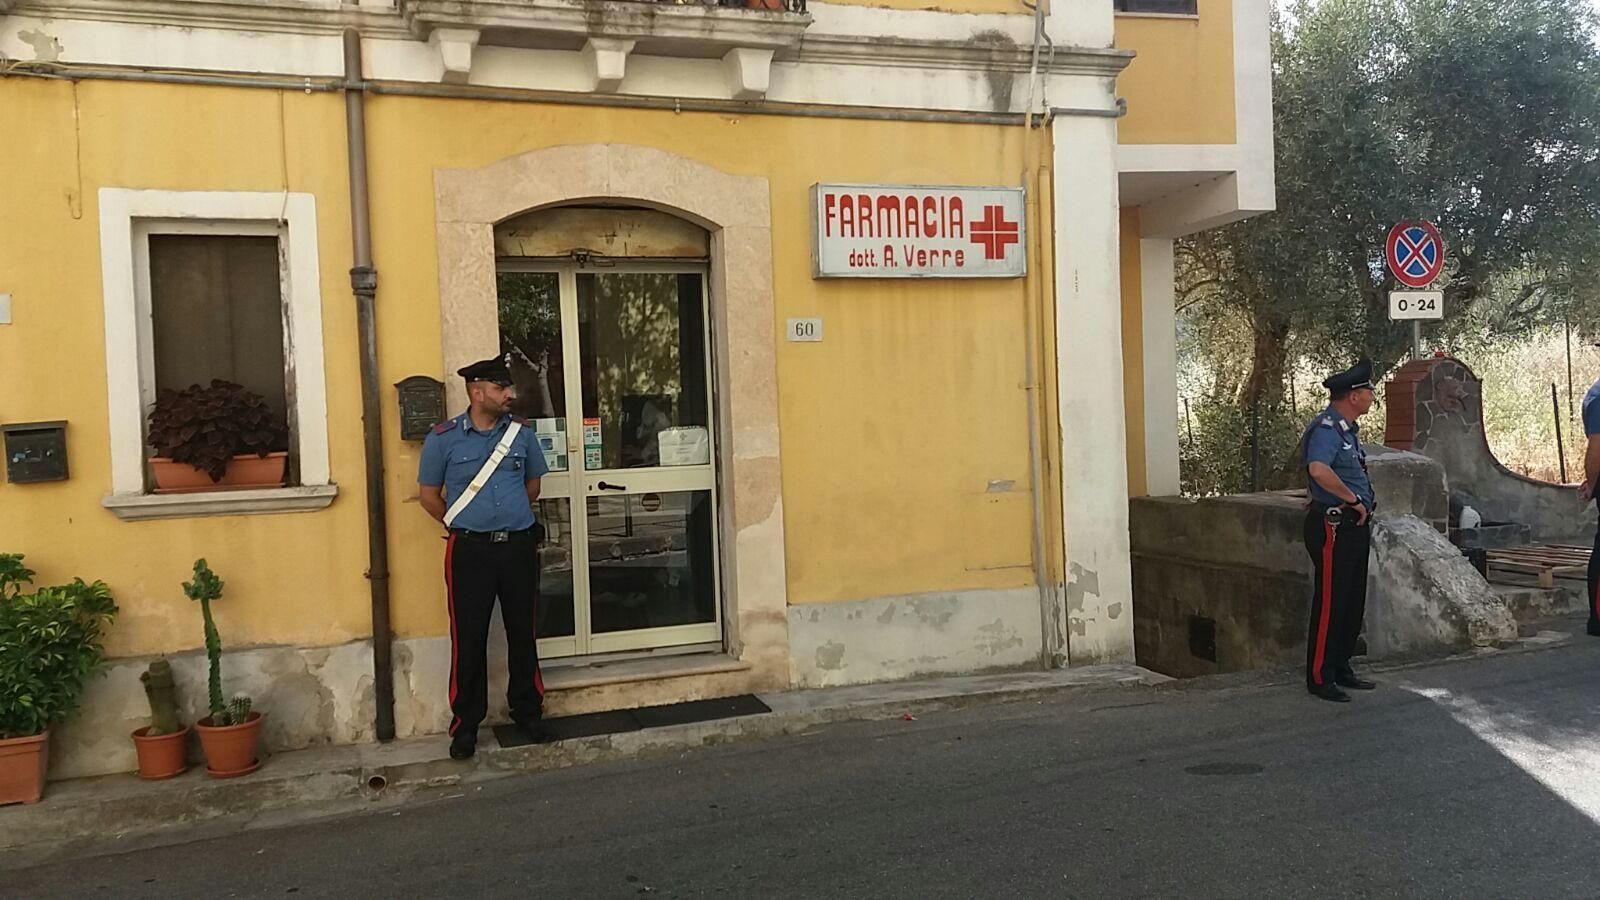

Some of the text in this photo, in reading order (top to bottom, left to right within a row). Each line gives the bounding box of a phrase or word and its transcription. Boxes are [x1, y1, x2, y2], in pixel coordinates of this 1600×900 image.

[825, 194, 963, 238] FARMACIA
[849, 244, 964, 267] dott. A. Verre
[796, 322, 813, 336] 60
